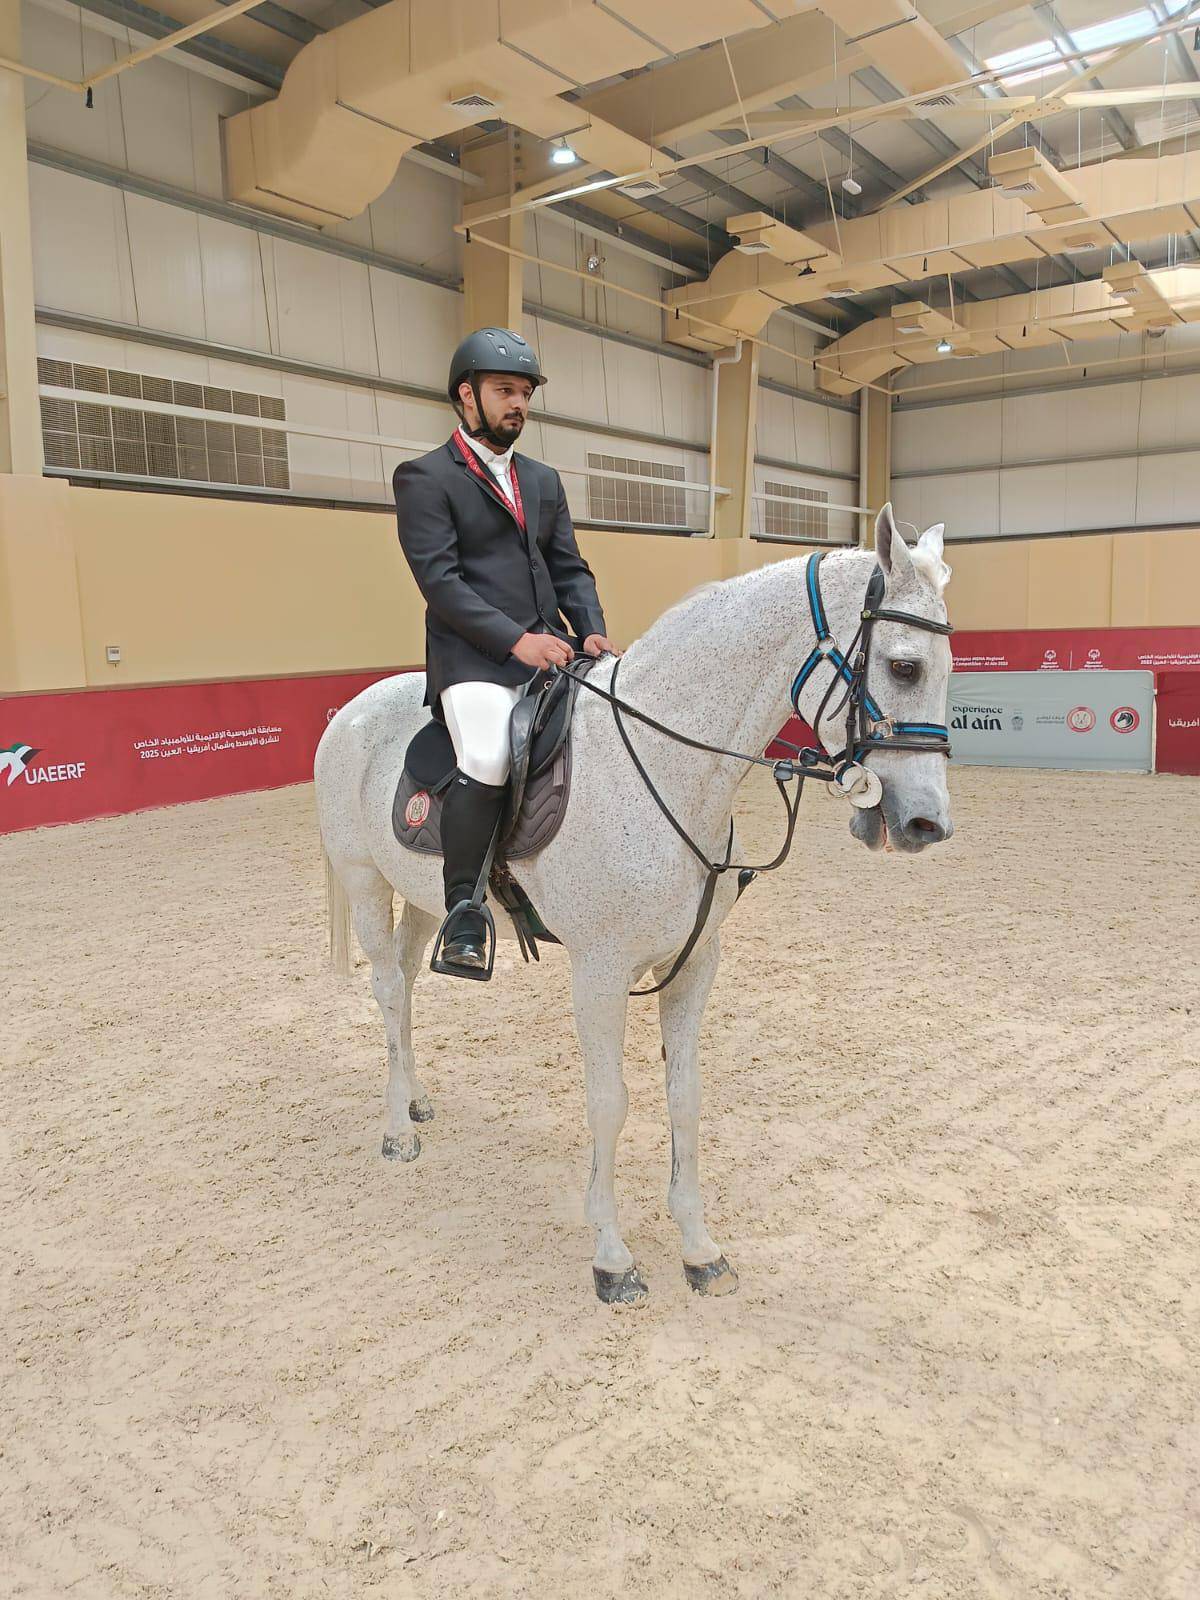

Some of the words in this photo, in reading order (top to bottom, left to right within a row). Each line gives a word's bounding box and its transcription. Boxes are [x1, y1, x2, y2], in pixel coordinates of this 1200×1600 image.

[952, 704, 1003, 714] experience
[951, 715, 968, 730] al
[226, 729, 257, 738] الفروسية
[257, 725, 282, 734] مسابقة
[160, 734, 195, 746] للأولمبياد
[195, 731, 226, 742] الإقليمية
[235, 736, 259, 747] الأوسط
[259, 734, 280, 746] للشرق
[133, 738, 160, 750] الخاص
[211, 740, 235, 751] وشمال
[140, 749, 160, 759] 2025
[160, 747, 182, 758] العين
[24, 762, 86, 785] UAEERF
